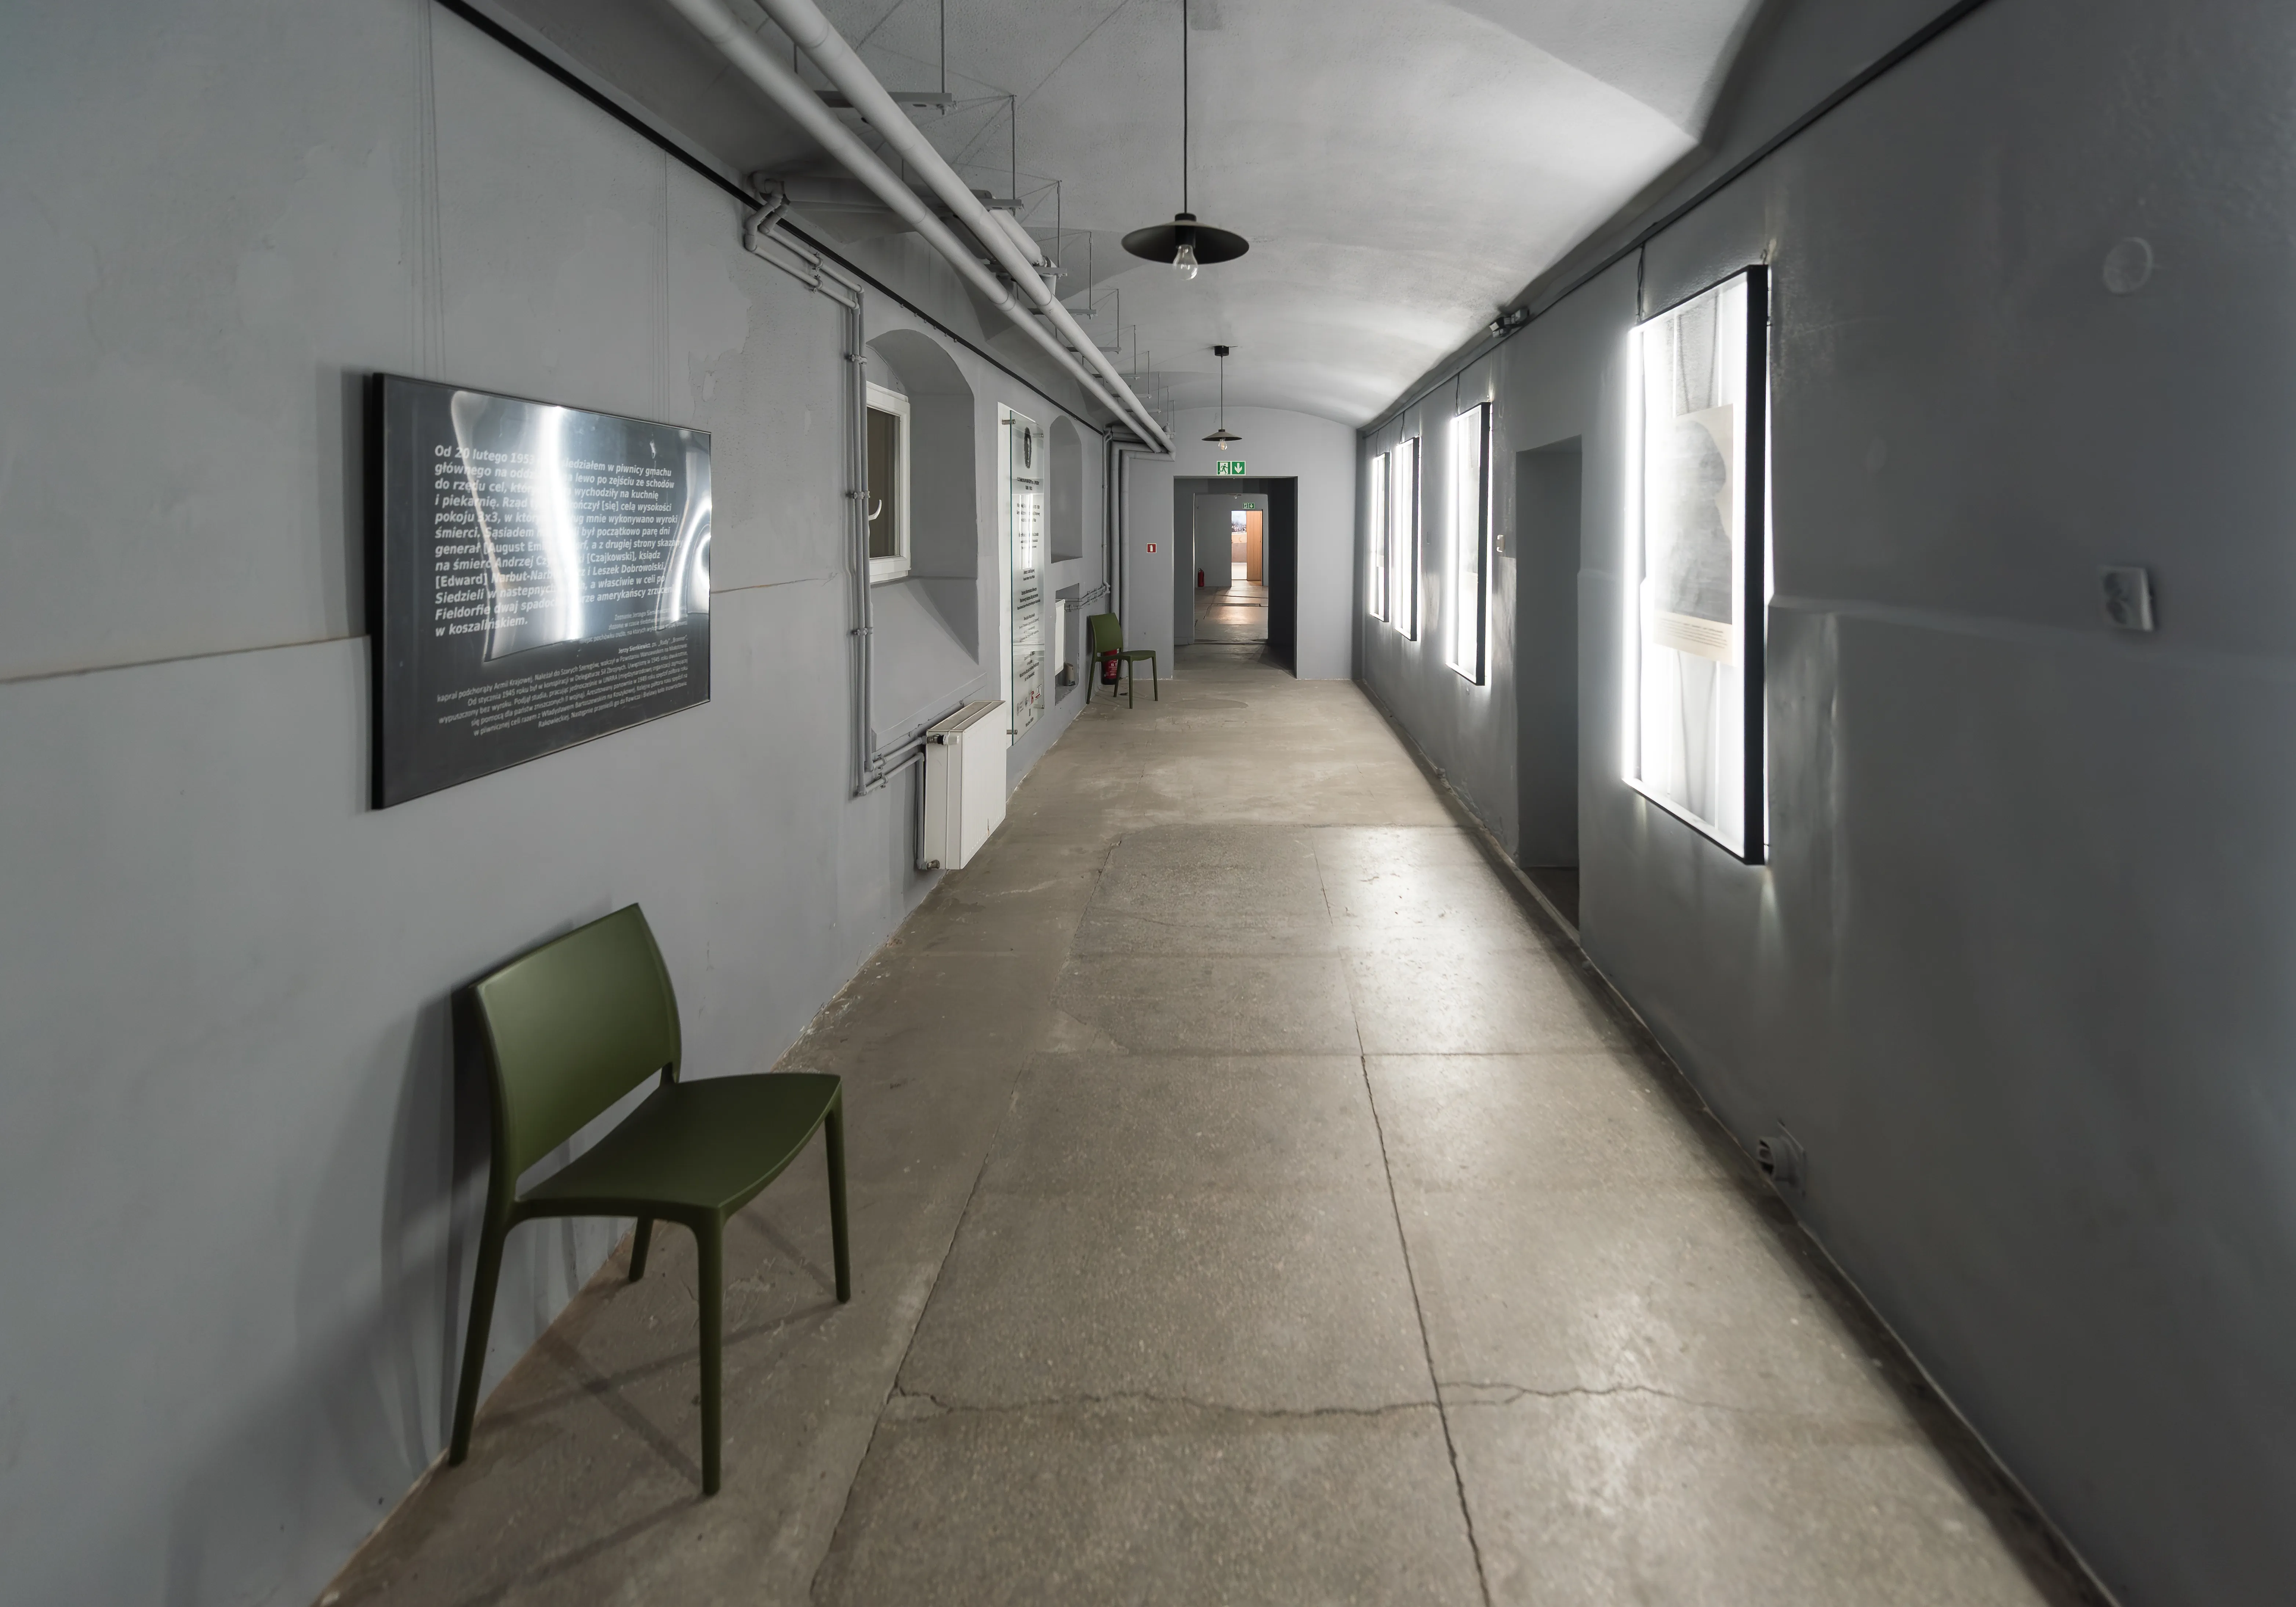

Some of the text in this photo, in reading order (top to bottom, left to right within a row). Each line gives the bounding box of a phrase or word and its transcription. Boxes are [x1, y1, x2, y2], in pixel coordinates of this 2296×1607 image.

[435, 445, 452, 457] Od
[455, 447, 470, 458] 20
[473, 449, 508, 464] lutego
[511, 452, 535, 464] 1953
[616, 463, 644, 476] piwnicy
[645, 468, 672, 477] gmachu
[435, 462, 491, 478] głównego
[495, 468, 507, 477] na
[575, 472, 595, 483] lewo
[597, 476, 607, 485] po
[609, 475, 634, 487] zejściu
[646, 479, 675, 488] schodów
[435, 477, 450, 489] do
[453, 480, 485, 493] rzędu
[489, 481, 506, 494] cel,
[574, 487, 618, 499] wychodziły
[631, 489, 658, 501] kuchnię
[435, 493, 440, 505] i
[502, 497, 527, 510] Rząd
[602, 500, 619, 512] [się]
[621, 502, 636, 512] celą
[638, 503, 672, 513] wysokości
[435, 510, 475, 525] pokoju
[504, 514, 512, 522] w
[586, 514, 606, 523] mnie
[608, 514, 654, 525] wykonywano
[656, 515, 677, 525] wyroki
[435, 526, 480, 539] śmierci.
[485, 526, 534, 540] Sąsiadem
[582, 526, 595, 538] był
[597, 527, 640, 538] początkowo
[642, 528, 658, 537] parę
[660, 526, 670, 535] dni
[435, 542, 481, 558] generał
[605, 539, 632, 550] drugiej
[633, 539, 656, 549] strony
[657, 538, 683, 548] skazany
[435, 562, 450, 571] na
[495, 555, 534, 568] Andrzej
[587, 551, 637, 564] [Czajkowski],
[639, 550, 661, 561] ksiądz
[436, 573, 488, 590] [Edward]
[588, 566, 591, 575] i
[592, 565, 620, 575] Leszek
[435, 588, 484, 604] Siedzieli
[644, 574, 655, 584] celi
[435, 604, 490, 620] Fieldorfie
[494, 600, 518, 614] dwaj
[597, 588, 646, 601] amerykańscy
[647, 584, 674, 595] zrzucen
[436, 616, 528, 637] w koszalińskiem.
